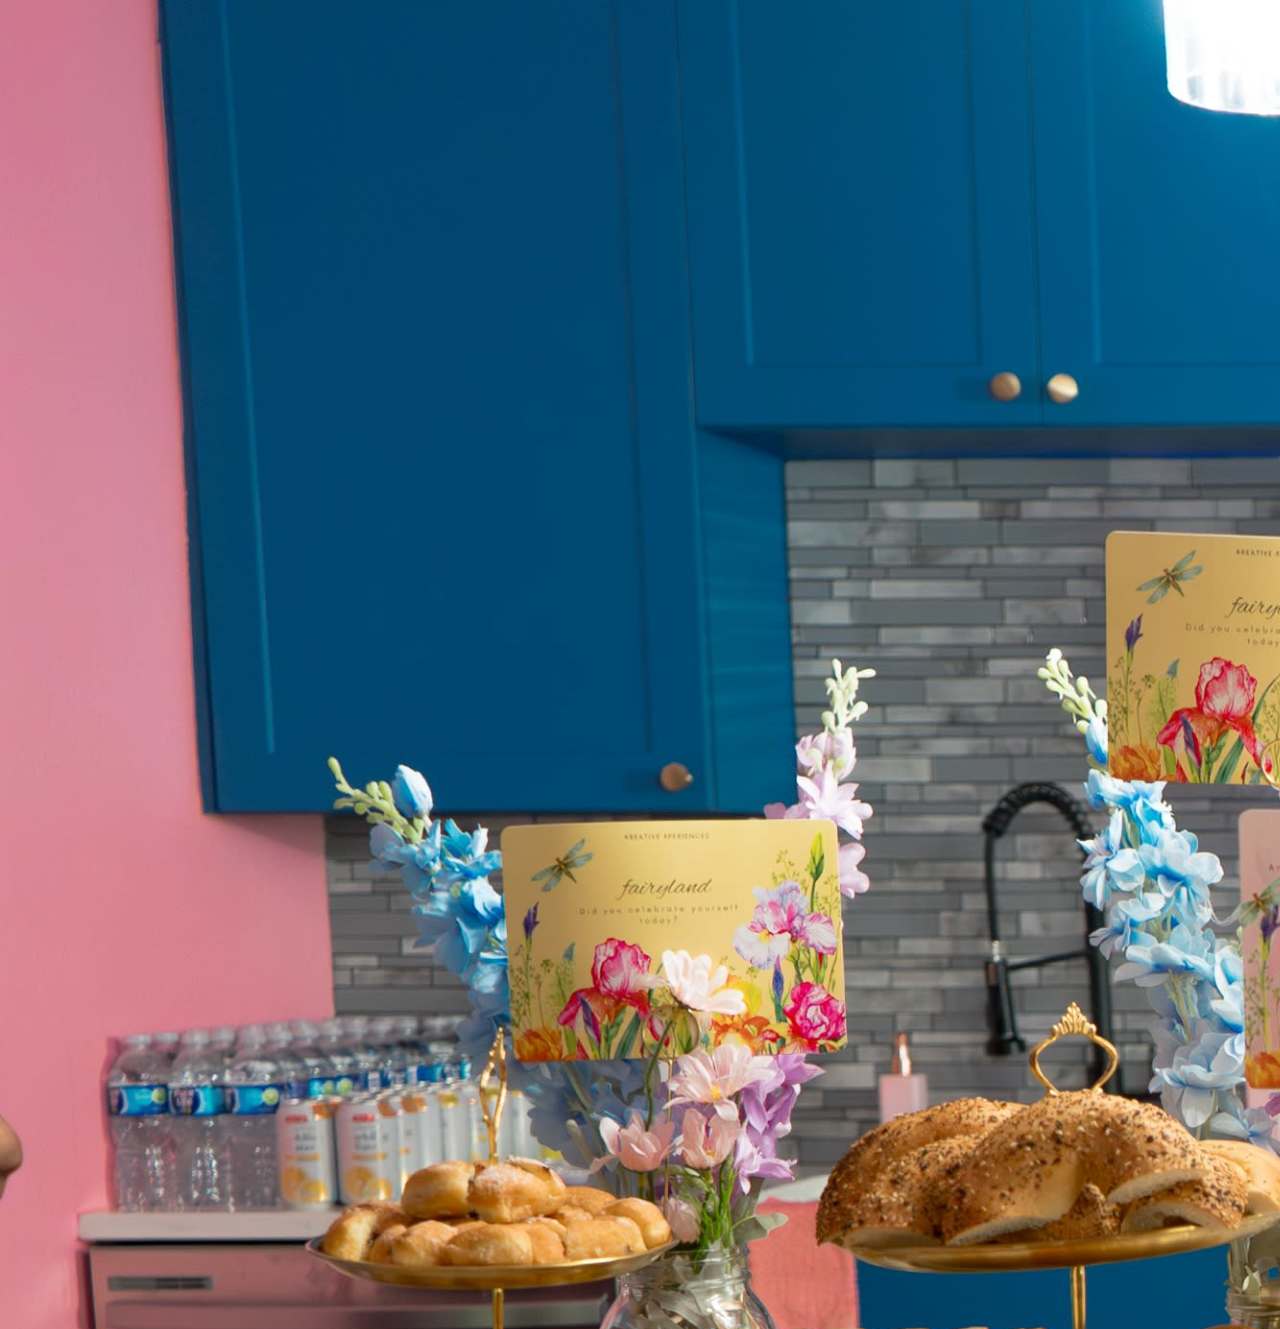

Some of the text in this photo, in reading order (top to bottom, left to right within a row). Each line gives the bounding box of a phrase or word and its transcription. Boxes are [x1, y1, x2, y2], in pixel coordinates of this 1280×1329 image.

[1185, 623, 1205, 632] Did
[1210, 625, 1230, 634] you
[615, 878, 713, 901] fairyland
[579, 903, 739, 916] Did you celebrate yourself
